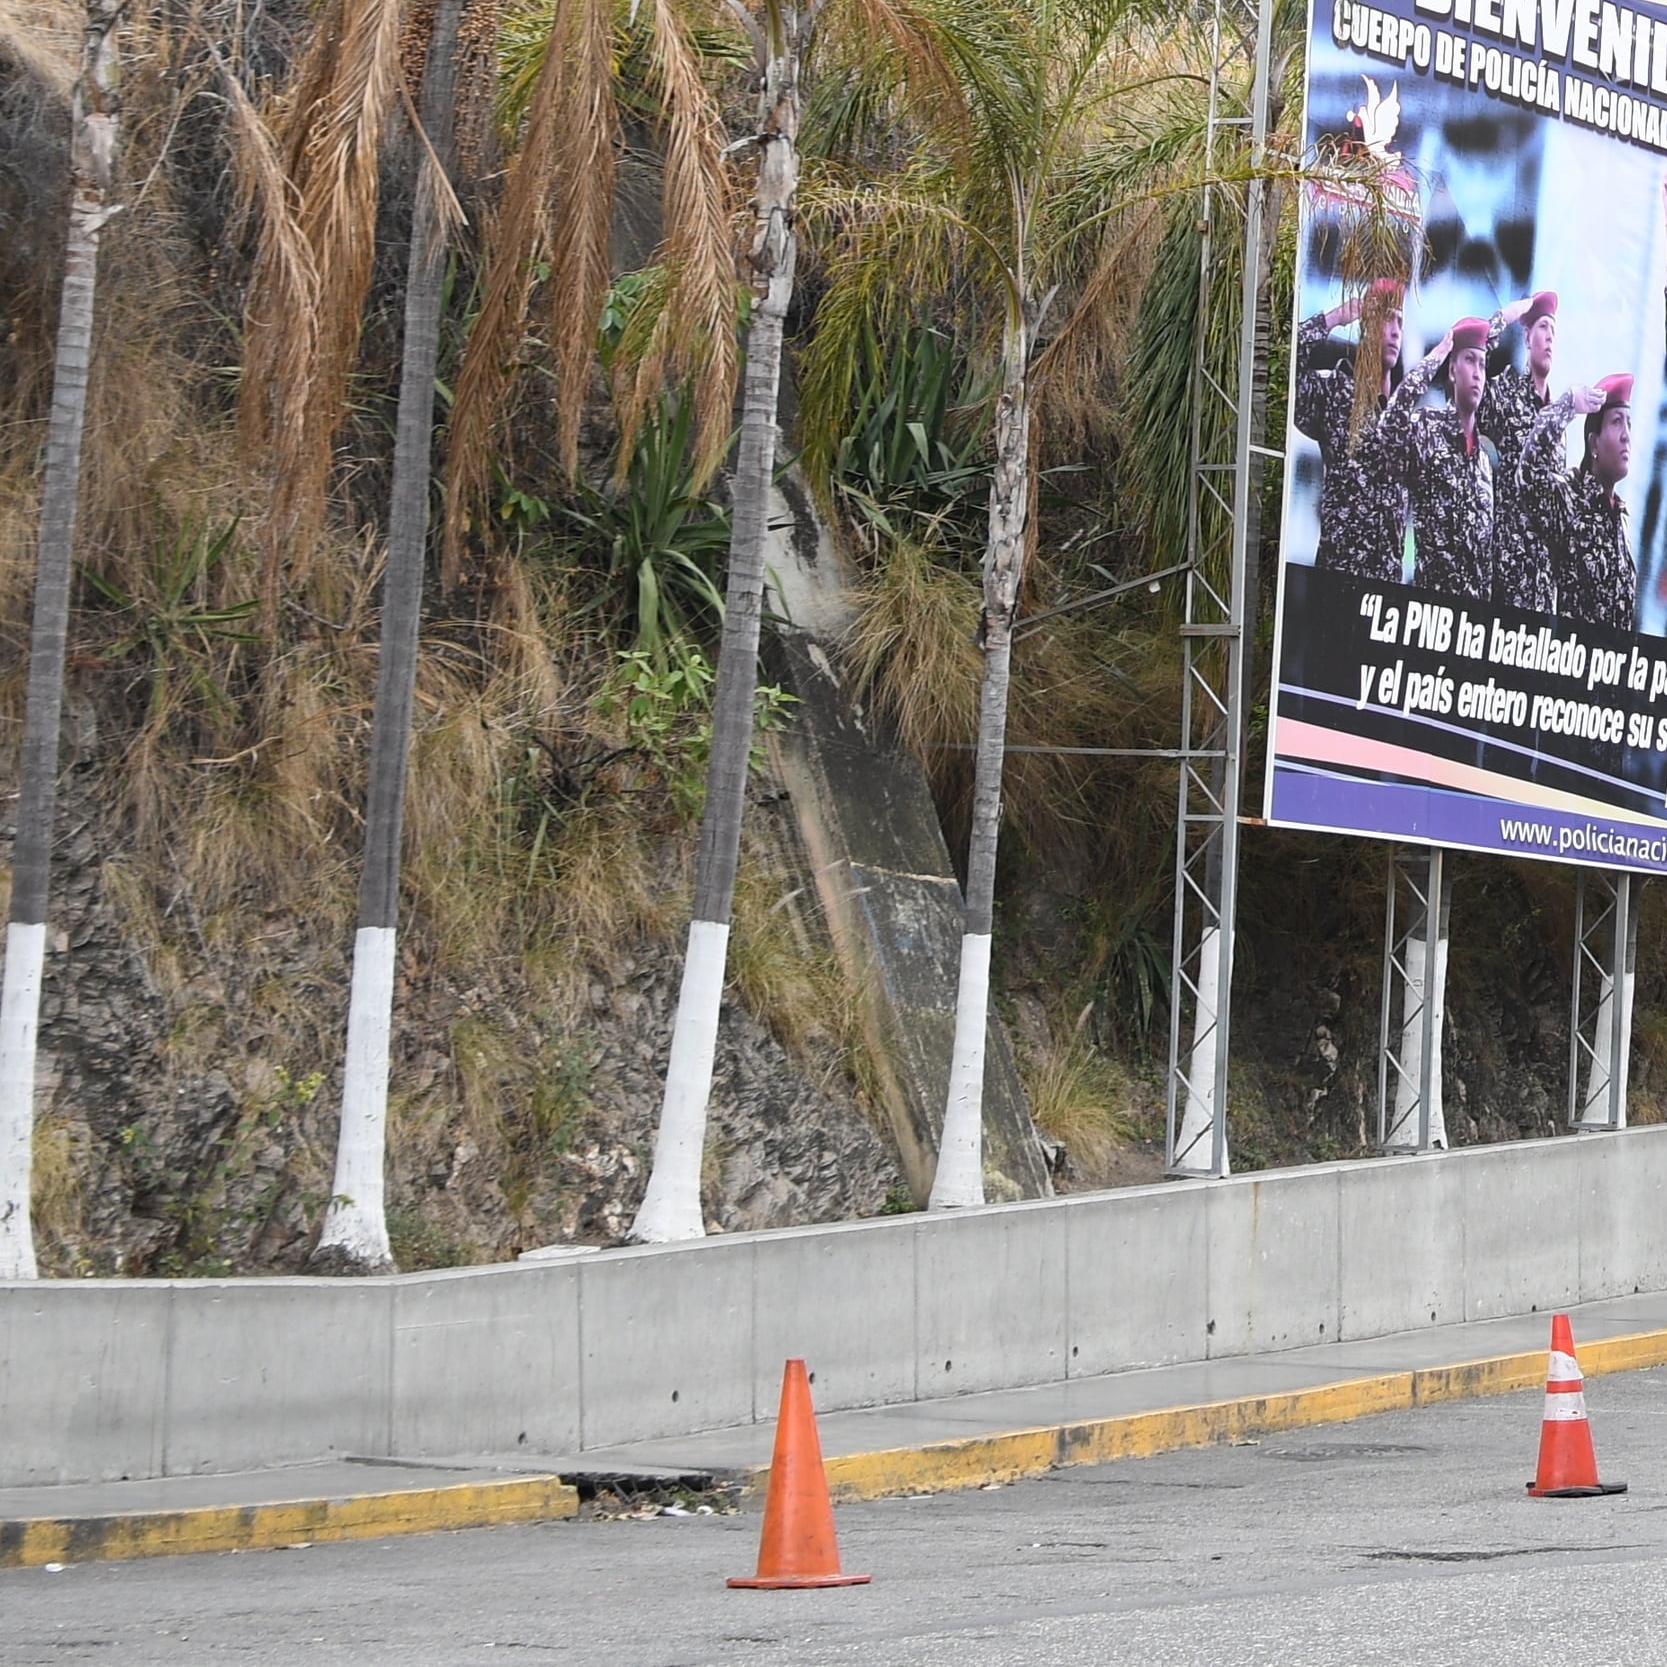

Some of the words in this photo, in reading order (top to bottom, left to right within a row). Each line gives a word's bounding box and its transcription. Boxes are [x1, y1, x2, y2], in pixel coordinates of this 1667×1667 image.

[1435, 29, 1466, 79] DE
[1470, 40, 1560, 112] POLICÍA
[1402, 600, 1454, 653] PNB
[1455, 611, 1486, 660] ha
[1488, 617, 1587, 679] batallado
[1587, 648, 1627, 691] por
[1627, 646, 1649, 691] la
[1356, 664, 1376, 710] y
[1378, 659, 1403, 705] el
[1402, 666, 1454, 717] país
[1457, 677, 1528, 727] entero
[1529, 694, 1625, 744] reconoce
[1627, 712, 1655, 749] su
